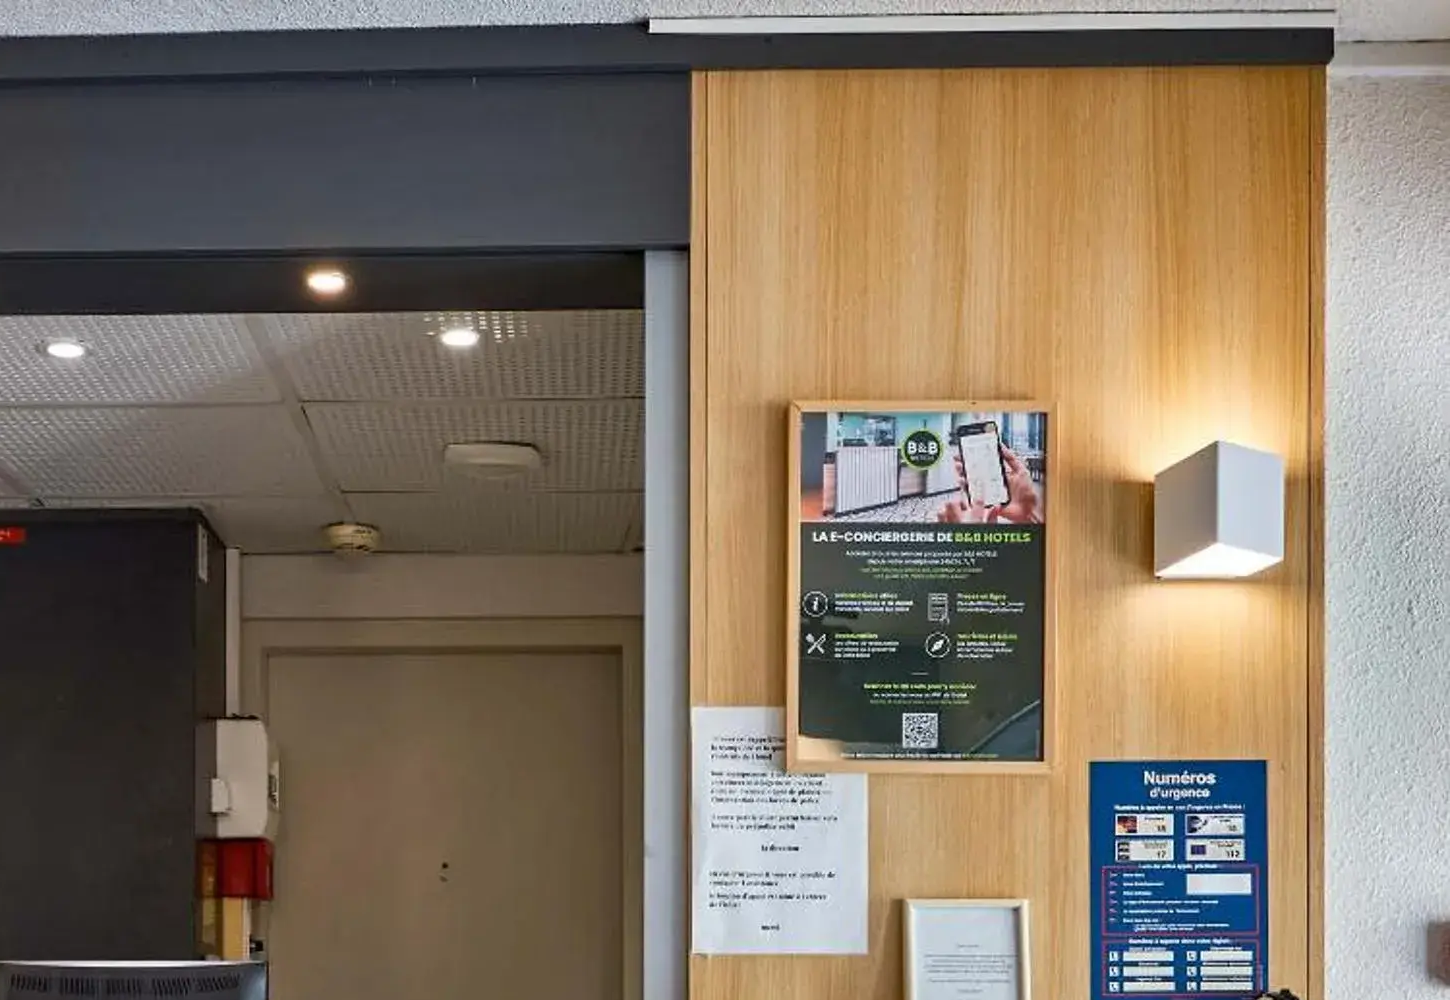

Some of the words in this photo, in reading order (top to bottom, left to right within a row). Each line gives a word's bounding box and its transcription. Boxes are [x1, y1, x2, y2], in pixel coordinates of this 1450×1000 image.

[907, 440, 939, 455] B&B
[812, 531, 828, 543] LA
[830, 531, 935, 543] E-CONCIERGERIE
[937, 531, 952, 543] DE
[983, 532, 1032, 543] HOTELS
[1143, 770, 1217, 785] Numéros
[1149, 788, 1211, 800] d'urgence
